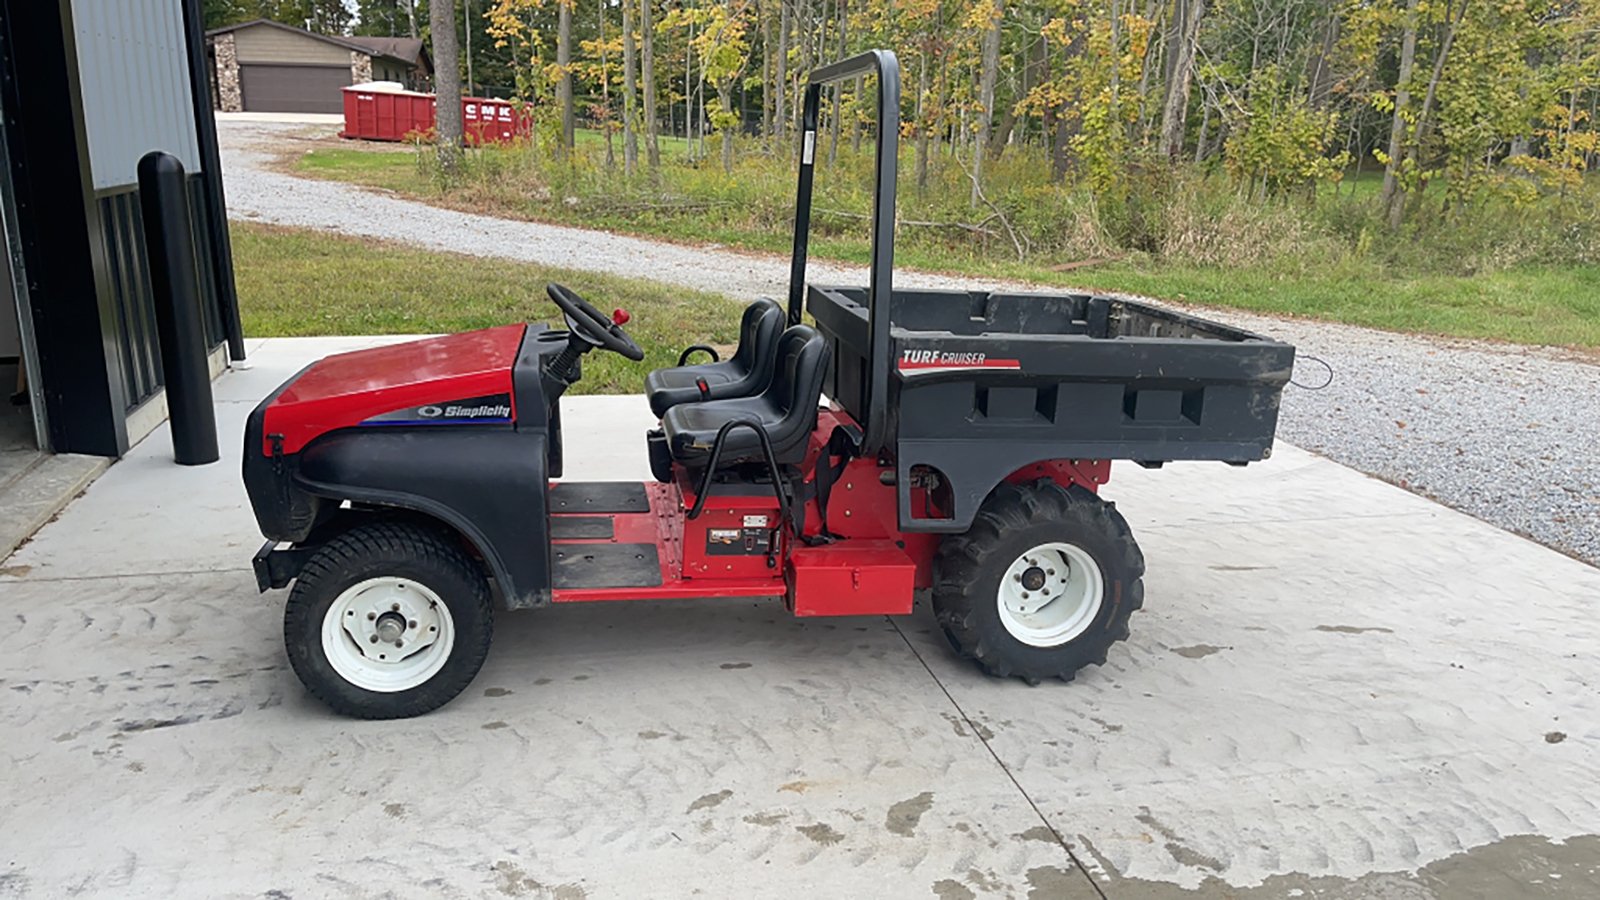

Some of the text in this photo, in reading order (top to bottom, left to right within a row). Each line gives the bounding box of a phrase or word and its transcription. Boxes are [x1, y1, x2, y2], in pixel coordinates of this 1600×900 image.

[903, 349, 986, 365] TURF CRUISER
[444, 405, 511, 418] Simplicity
